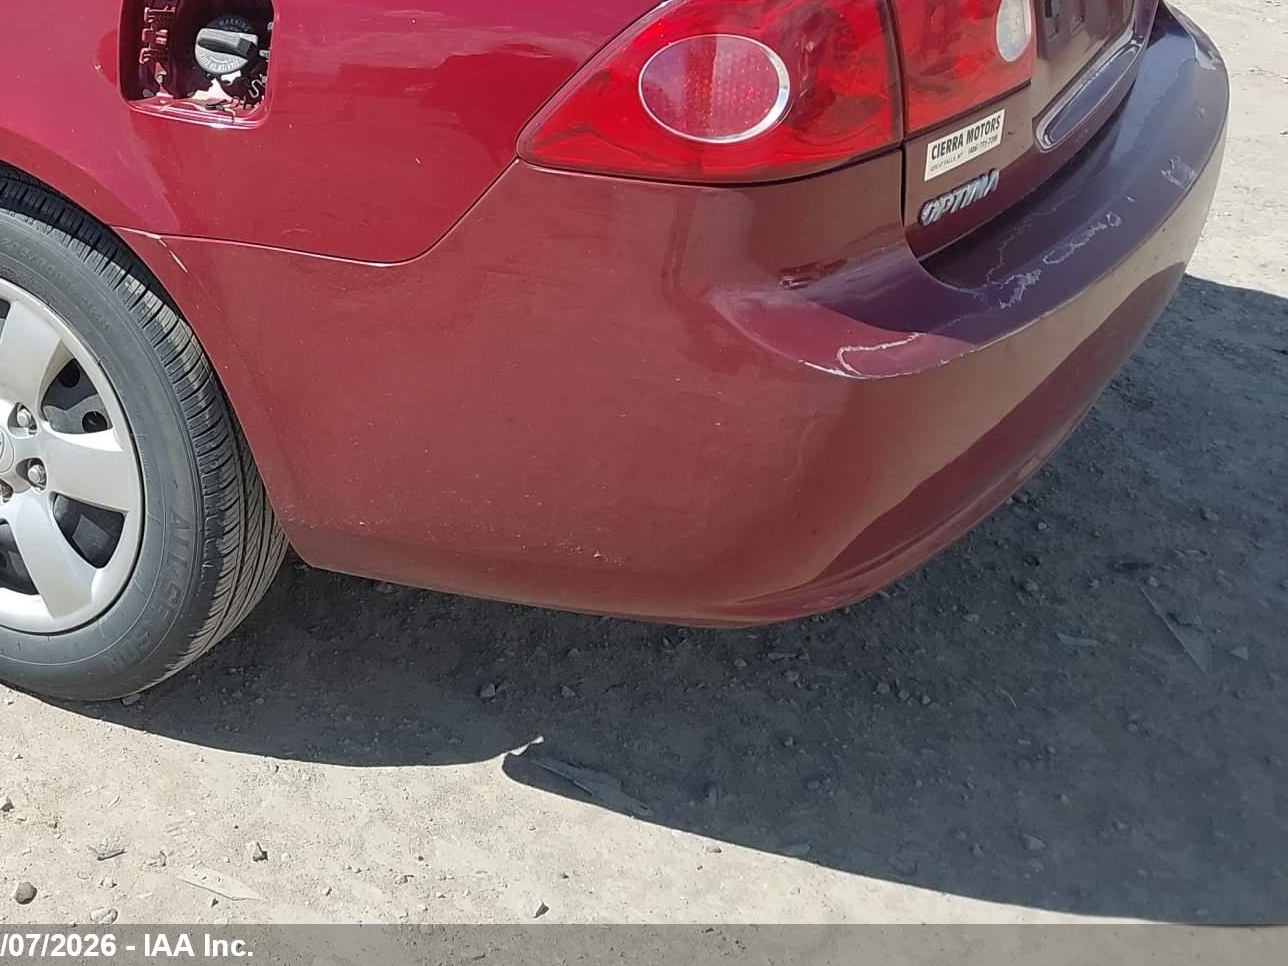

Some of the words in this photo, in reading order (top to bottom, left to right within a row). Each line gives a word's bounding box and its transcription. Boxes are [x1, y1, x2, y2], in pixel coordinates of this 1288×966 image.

[931, 132, 964, 161] CIERRA
[966, 114, 1001, 146] MOTORS
[918, 167, 1000, 227] OPTIMA
